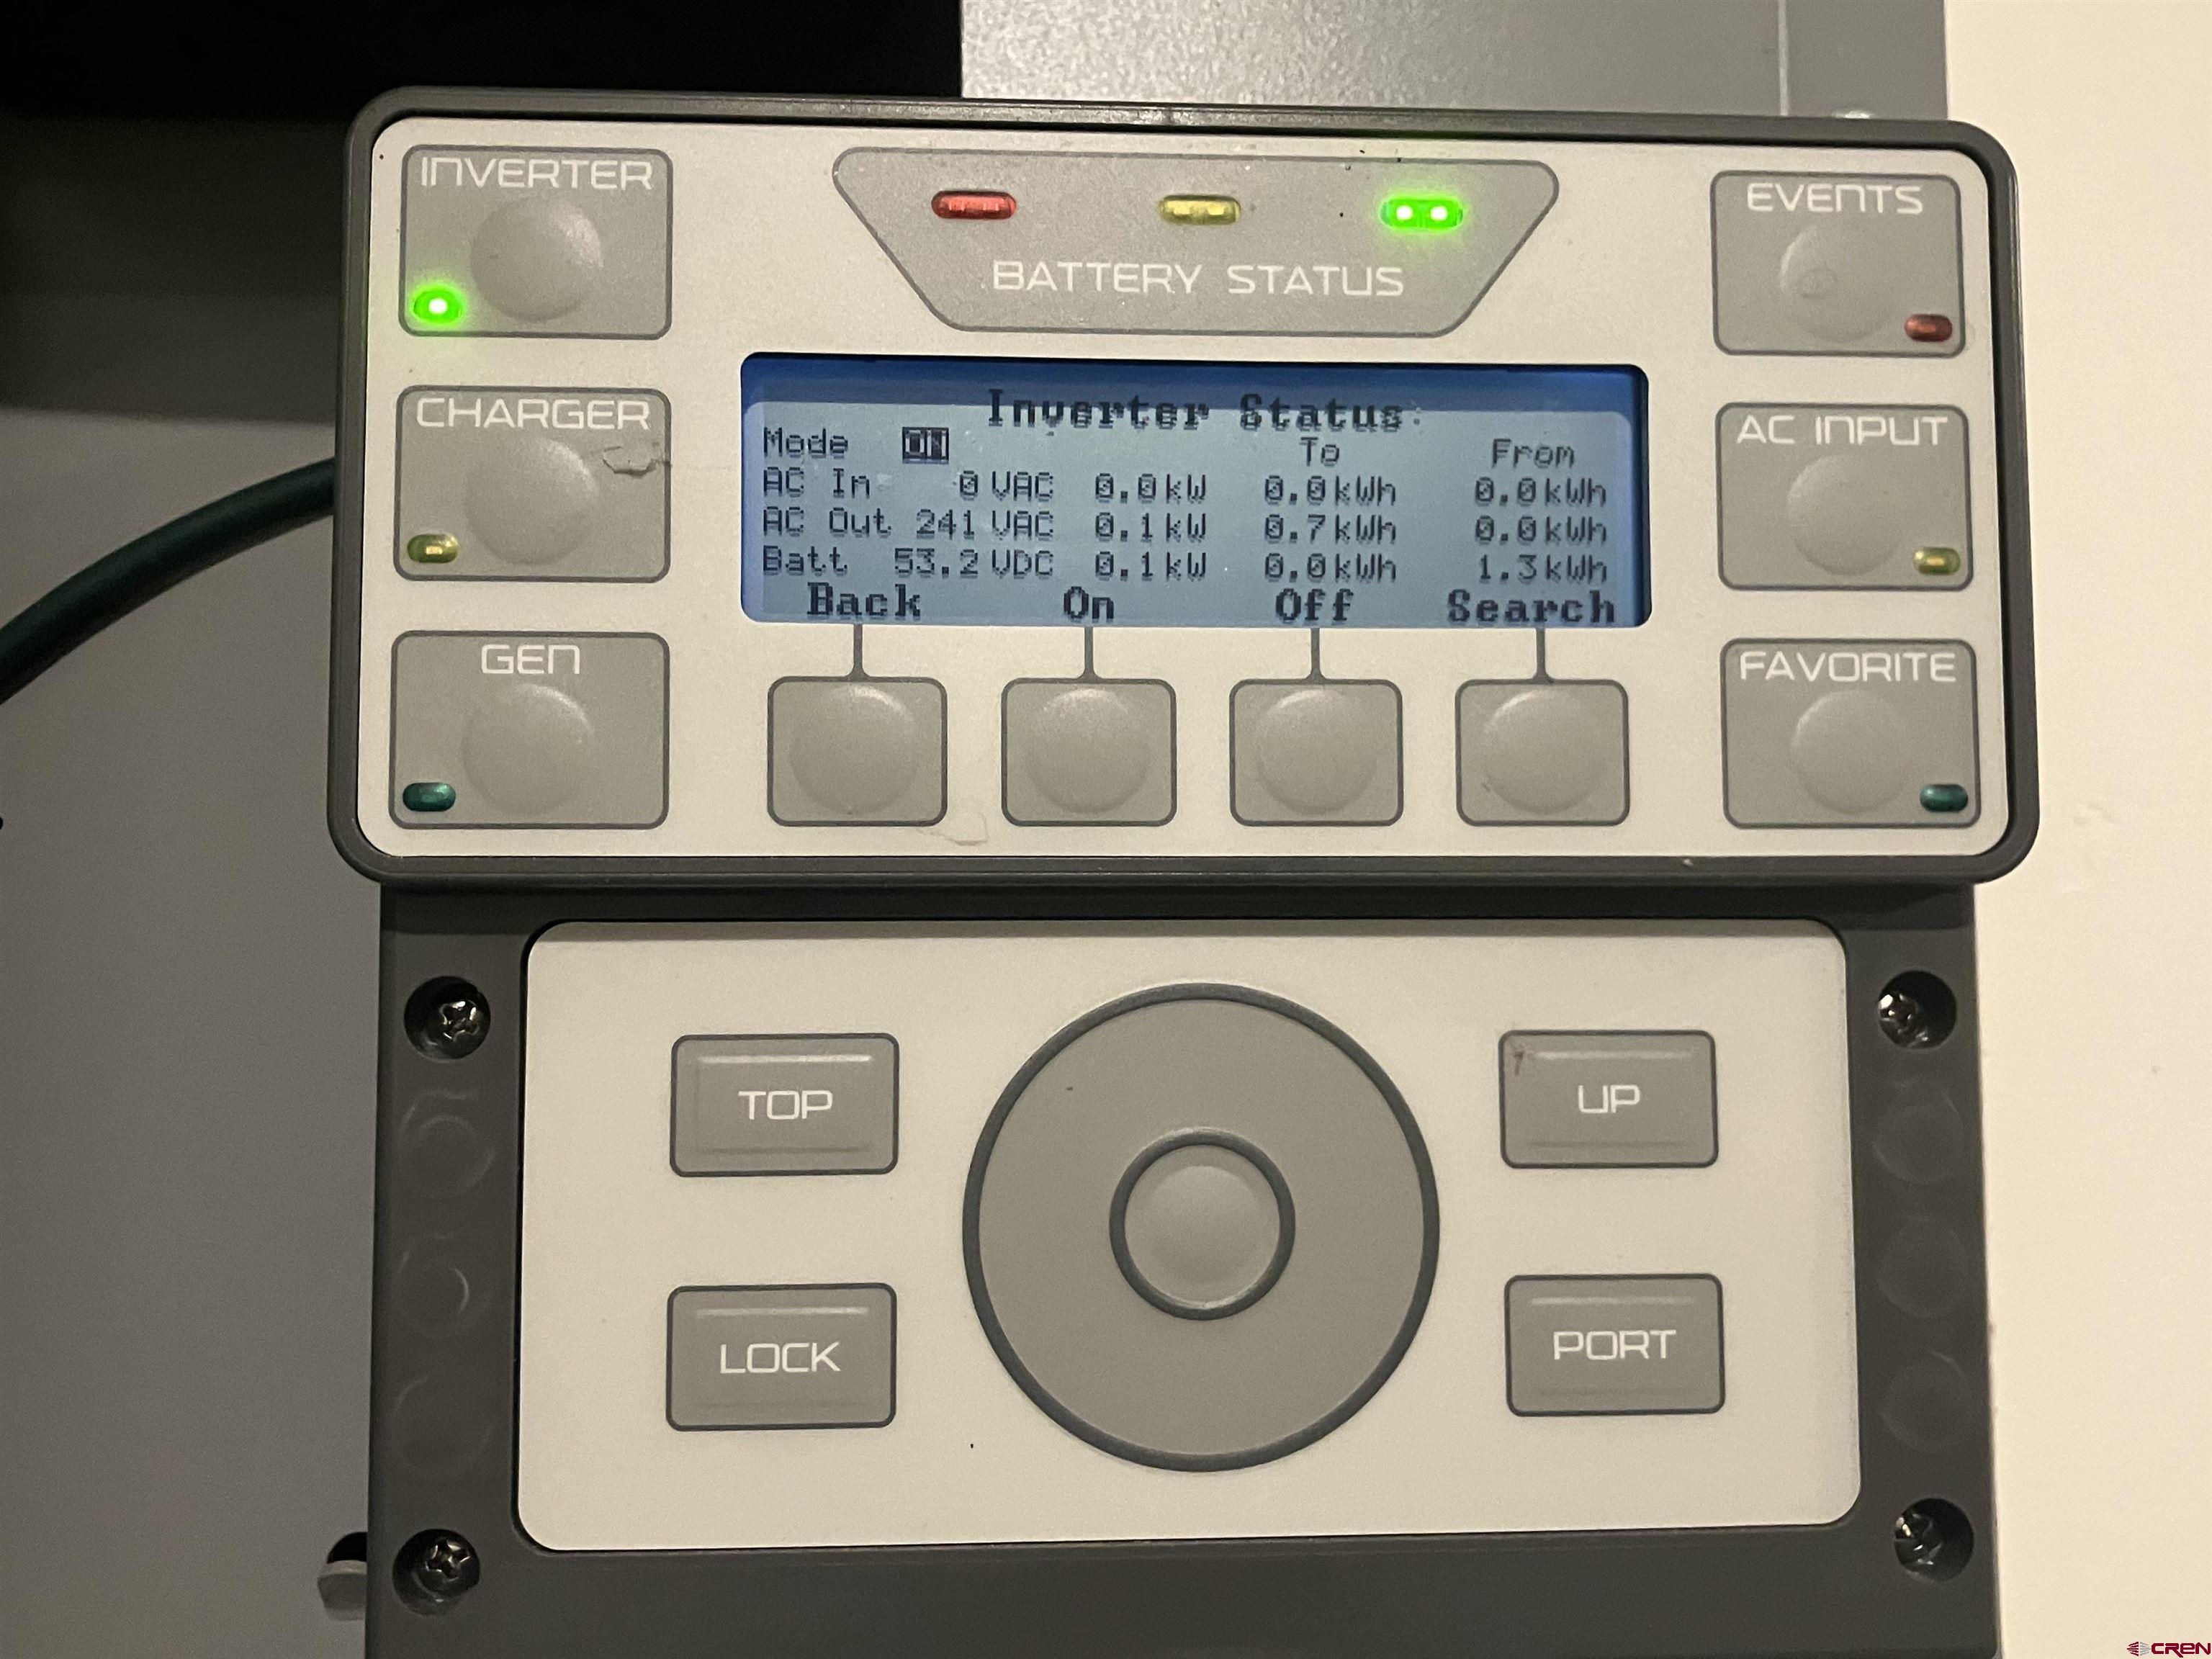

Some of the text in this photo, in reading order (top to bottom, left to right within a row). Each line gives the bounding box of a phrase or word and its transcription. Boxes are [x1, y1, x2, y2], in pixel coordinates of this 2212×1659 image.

[421, 156, 653, 190] INVERTER
[1747, 182, 1923, 215] EVENTS
[992, 260, 1403, 297] BATTERY STATUS
[416, 397, 650, 430] CHARGER
[989, 388, 1403, 432] Inverter Status
[763, 427, 948, 459] Mode ON
[1736, 415, 1948, 446] AC INPUT
[1300, 436, 1575, 468] To From
[763, 467, 804, 498] AC
[833, 468, 871, 499] In
[960, 471, 979, 500] 0
[992, 472, 1054, 501] VAC
[763, 506, 804, 538] AC
[829, 507, 892, 539] Out
[916, 508, 976, 539] 241
[992, 510, 1054, 541] VAC
[763, 545, 848, 575] Batt
[894, 547, 979, 578] 53.2
[992, 549, 1054, 579] VDC
[807, 582, 921, 620] Back
[1063, 586, 1114, 621] On
[1276, 588, 1354, 624] Off
[1447, 588, 1615, 625] Search
[480, 644, 581, 675] GEN
[1740, 651, 1956, 683] FAVORITE
[738, 1090, 833, 1120] TOP
[1578, 1084, 1640, 1114] UP
[720, 1341, 840, 1374] LOCK
[1553, 1329, 1677, 1360] PORT
